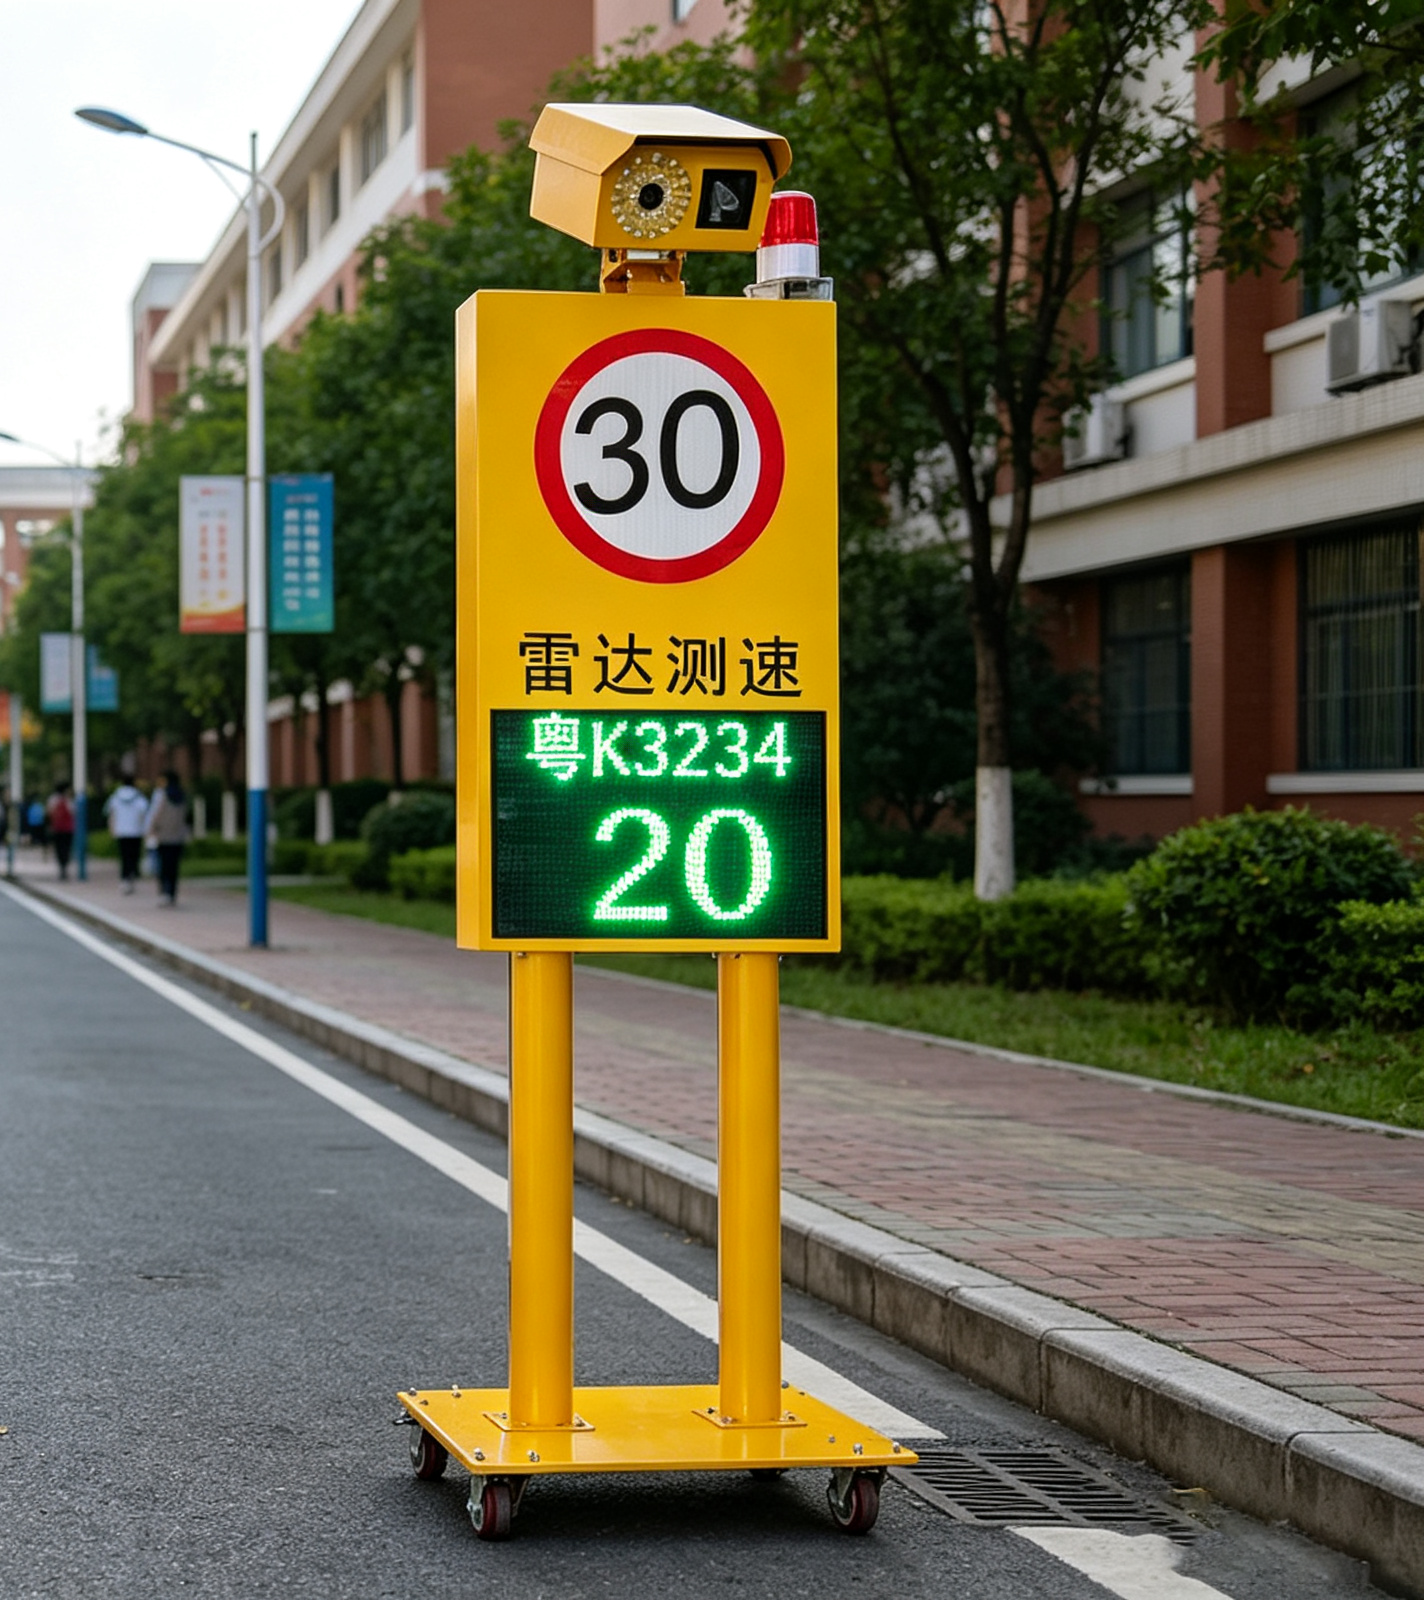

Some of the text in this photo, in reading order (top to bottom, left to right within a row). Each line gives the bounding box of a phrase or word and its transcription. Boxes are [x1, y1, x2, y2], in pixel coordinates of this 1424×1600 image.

[574, 390, 740, 515] 30
[519, 632, 803, 697] 雷达测速
[525, 713, 792, 780] 粤K3234
[592, 807, 773, 921] 20
